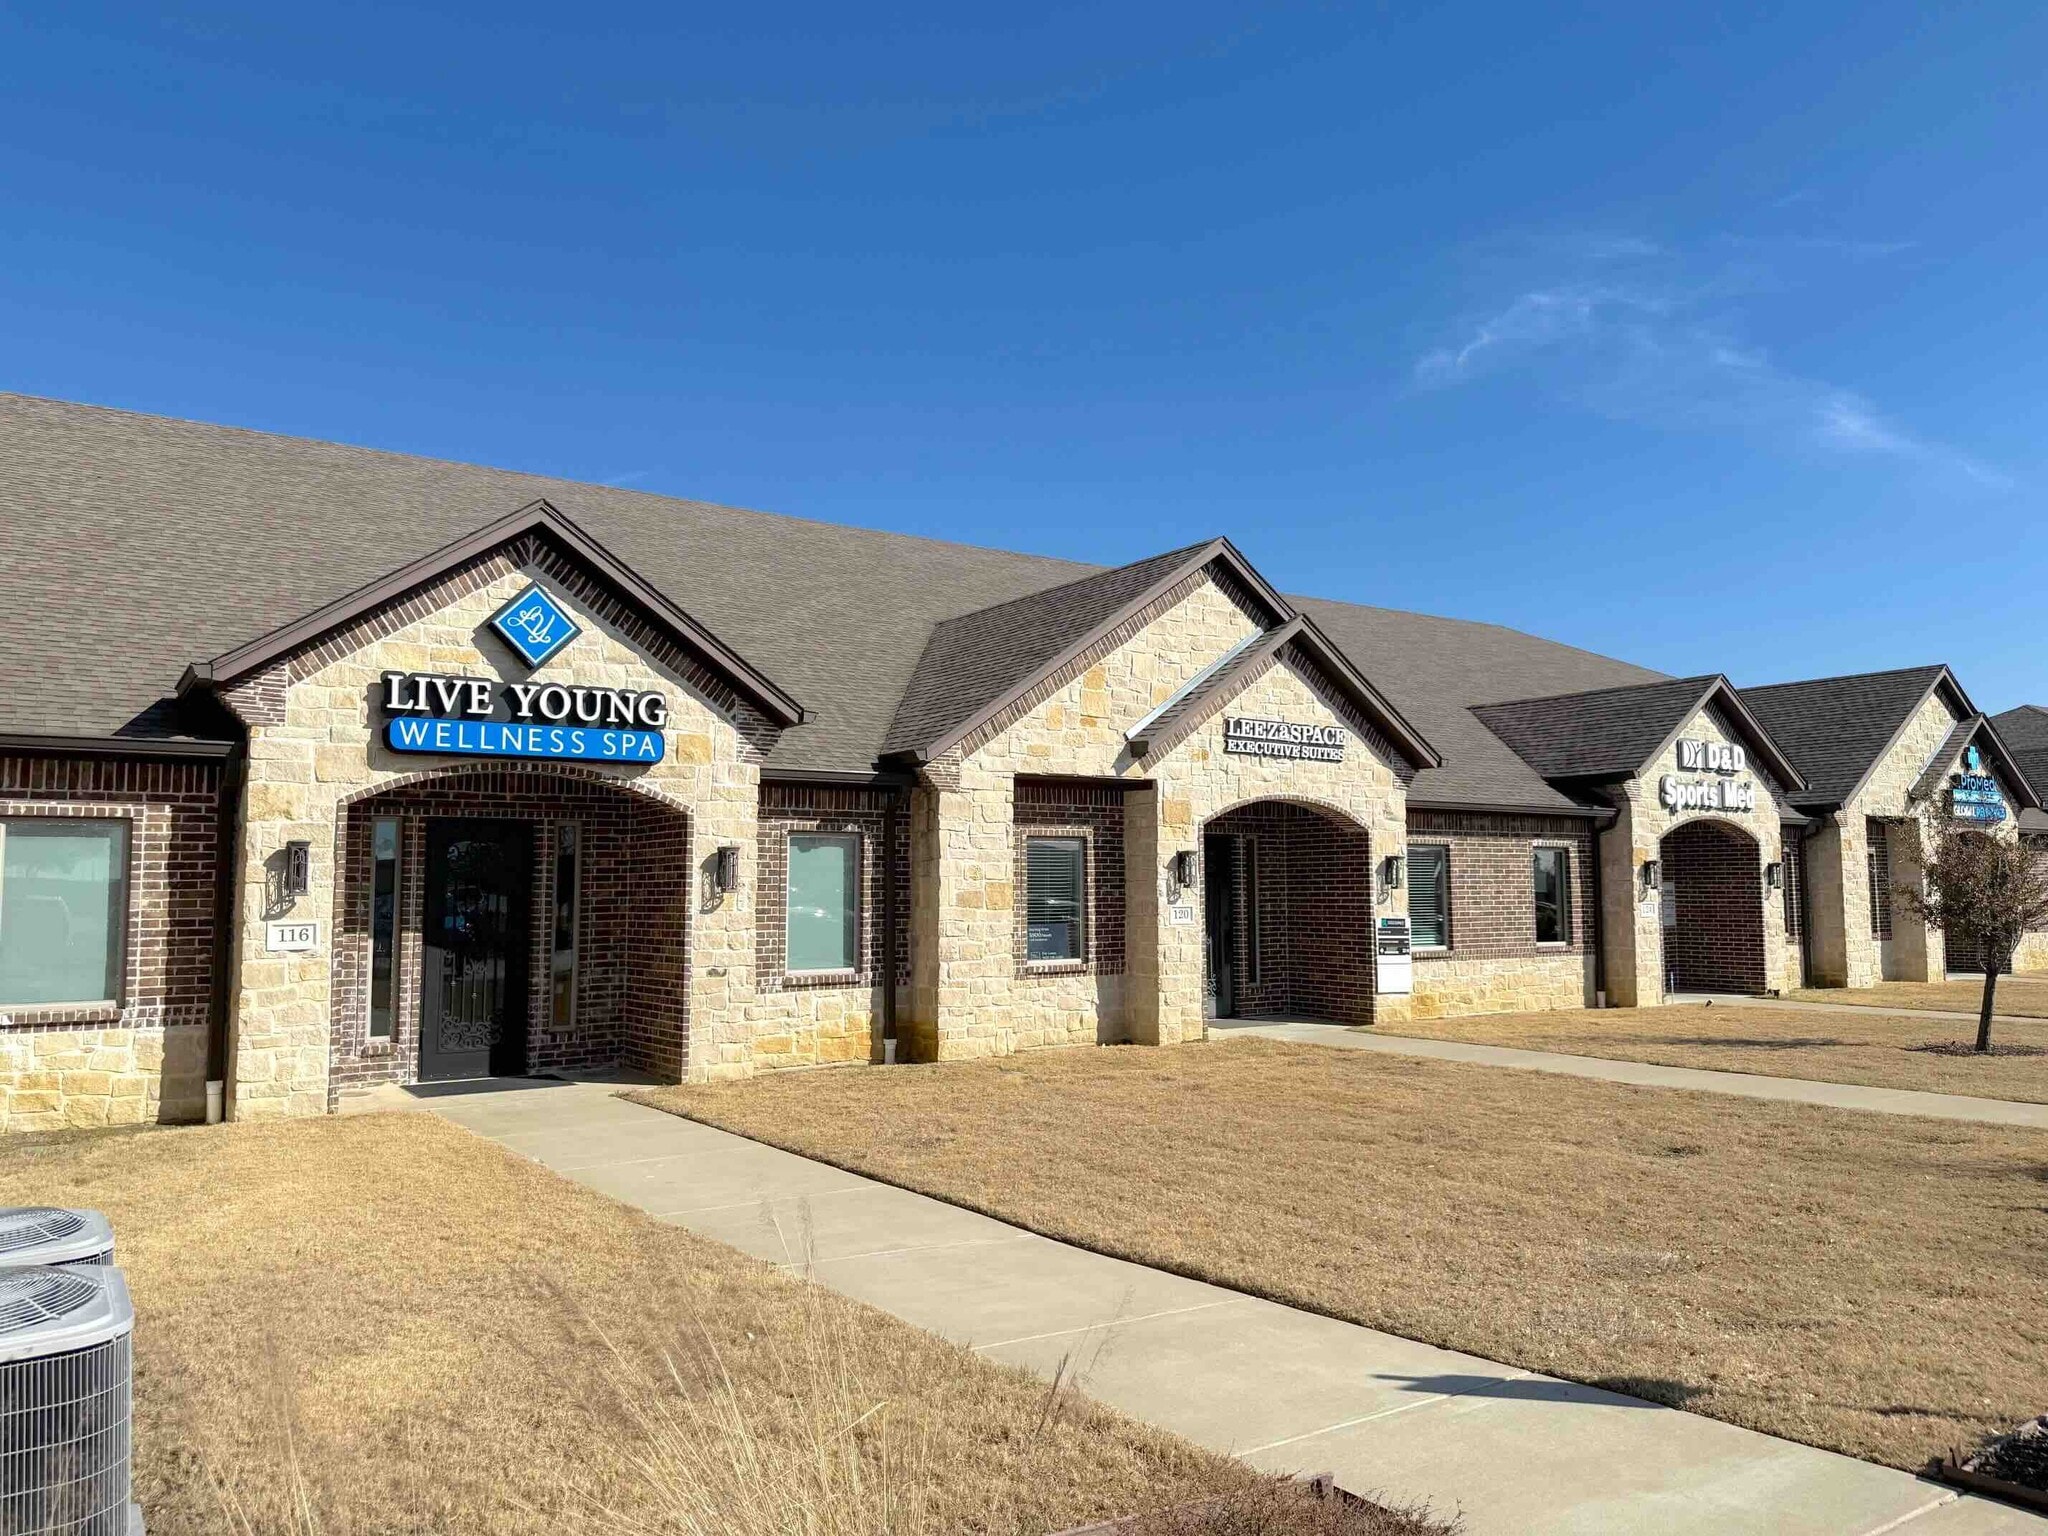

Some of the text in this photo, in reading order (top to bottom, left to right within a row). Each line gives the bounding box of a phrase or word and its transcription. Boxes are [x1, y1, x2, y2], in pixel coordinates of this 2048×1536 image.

[386, 674, 668, 726] LIVE YOUNG
[399, 720, 656, 758] WELLNESS SPA
[1227, 718, 1345, 746] LEEZaSPACE
[1227, 740, 1345, 760] EXECUTIVE SUITES
[1662, 776, 1756, 810] Sports Med
[1174, 910, 1189, 919] 120
[278, 928, 309, 943] 116
